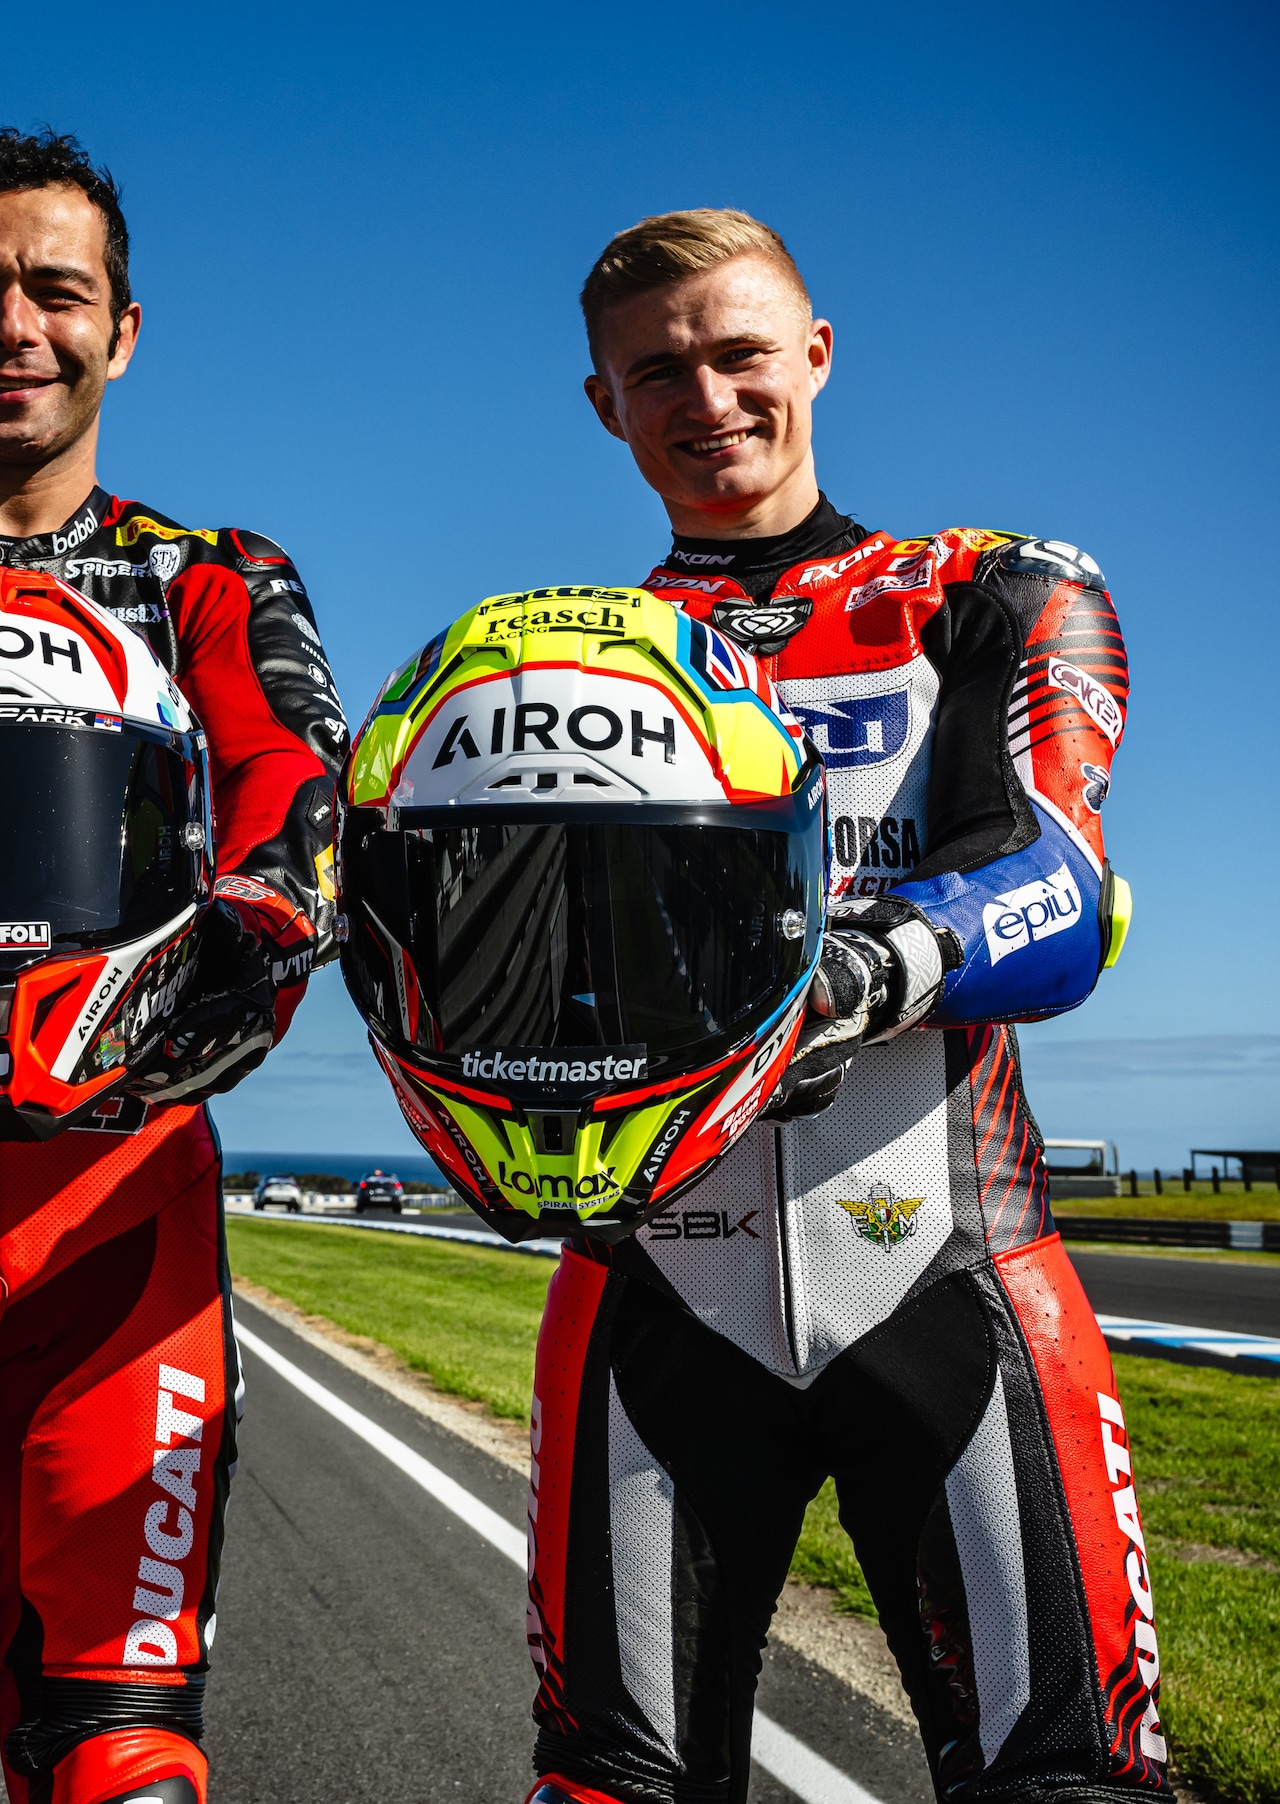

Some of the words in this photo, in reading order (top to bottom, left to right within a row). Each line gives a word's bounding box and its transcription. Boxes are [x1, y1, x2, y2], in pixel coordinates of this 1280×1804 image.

[52, 508, 98, 556] babol
[484, 626, 548, 644] RACING
[485, 607, 626, 635] reasch
[431, 702, 676, 770] AIROH
[834, 815, 921, 869] ORSA
[79, 967, 123, 1041] AIROH
[461, 1051, 647, 1082] ticketmaster
[438, 1110, 488, 1187] AIROH
[643, 1110, 691, 1183] AIROH
[537, 1200, 574, 1209] SPIRAL
[578, 1190, 620, 1210] SYSTEMS
[648, 1210, 762, 1240] SBK
[123, 1363, 205, 1666] DUCATI
